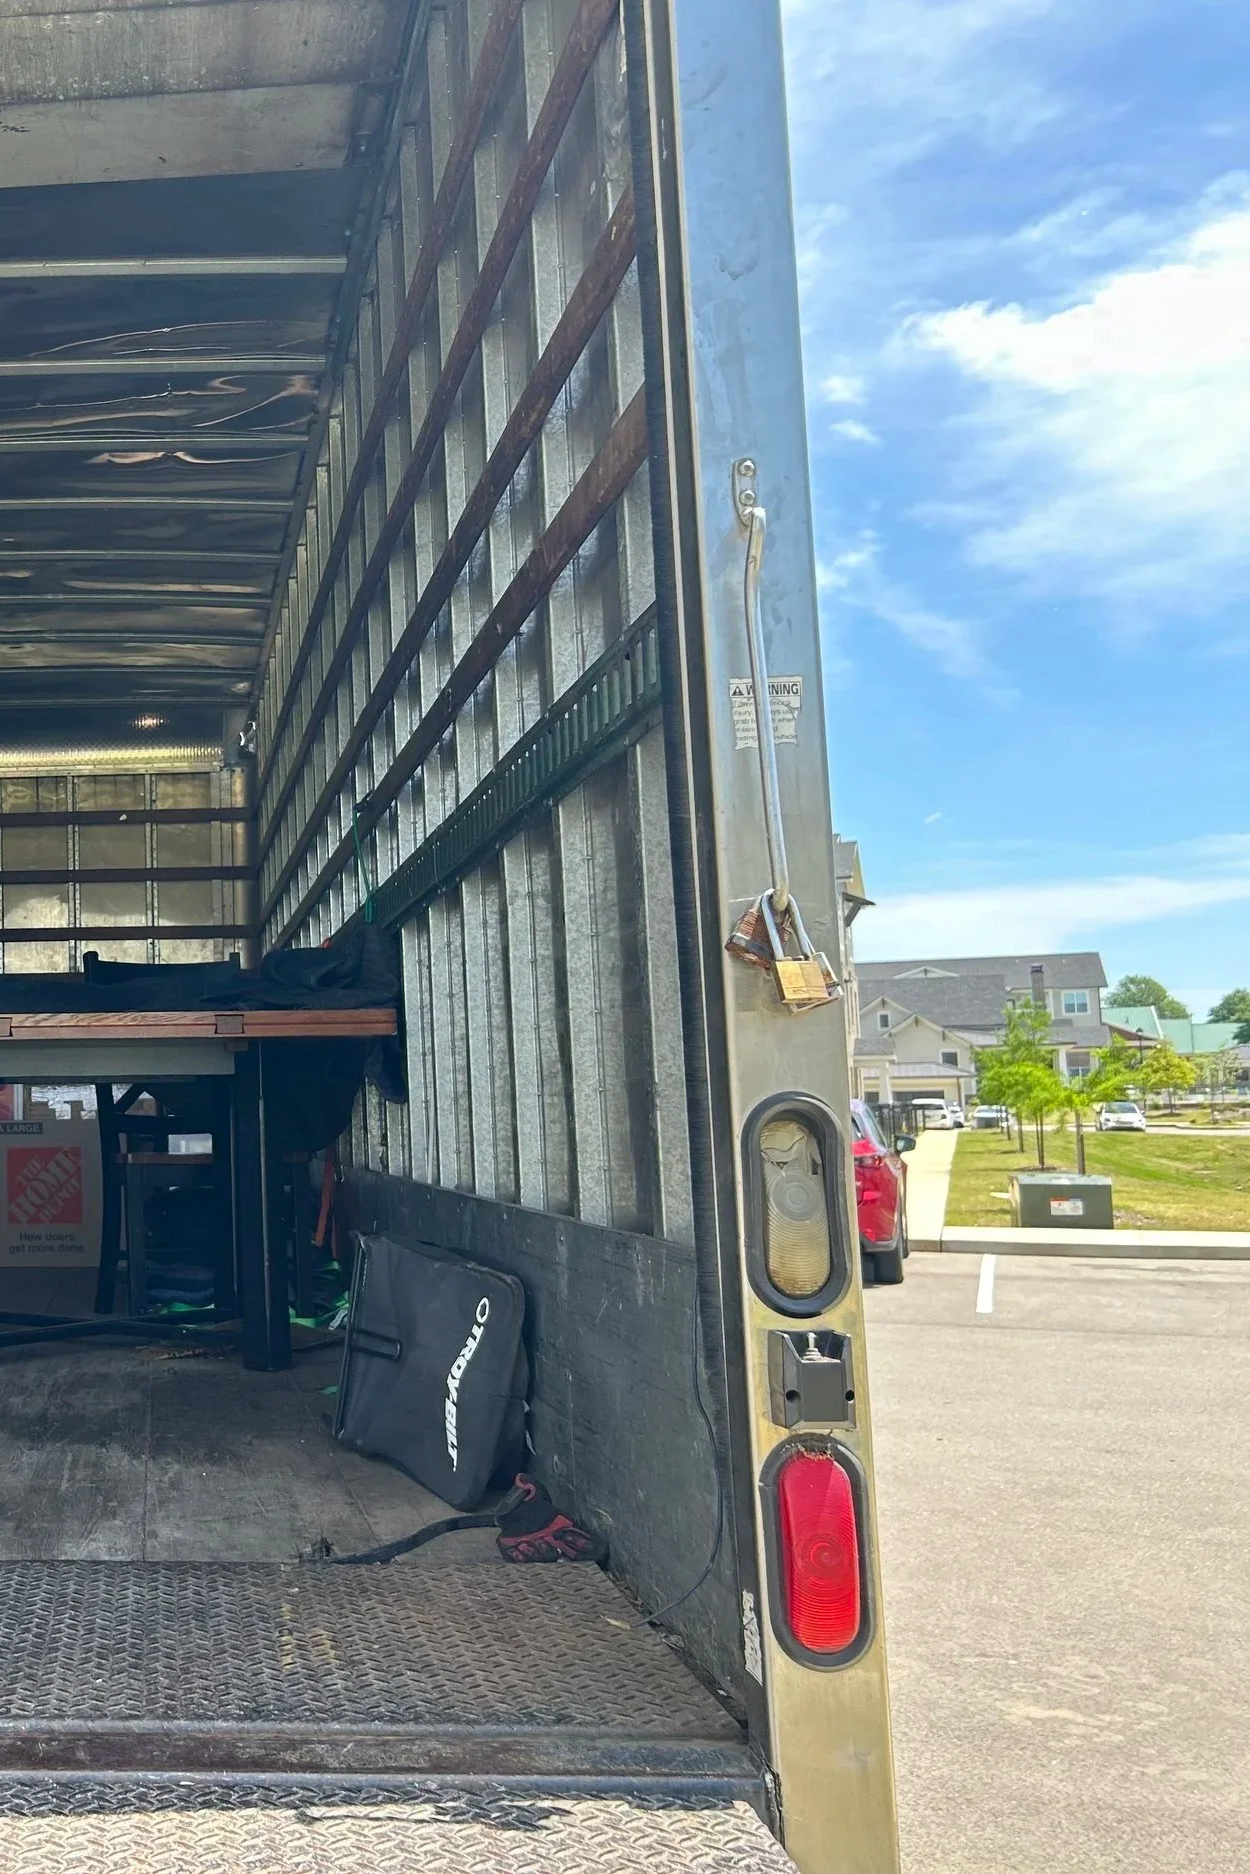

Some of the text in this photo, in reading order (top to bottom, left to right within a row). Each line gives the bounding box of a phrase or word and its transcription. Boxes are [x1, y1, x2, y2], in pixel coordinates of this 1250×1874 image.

[746, 684, 799, 695] WNING
[6, 1124, 39, 1133] LARGE
[14, 1154, 46, 1187] THE
[9, 1147, 81, 1223] HOME
[38, 1176, 81, 1223] DEPOT
[19, 1232, 75, 1242] How doers
[8, 1244, 26, 1255] get
[445, 1324, 484, 1468] TROY-BILT
